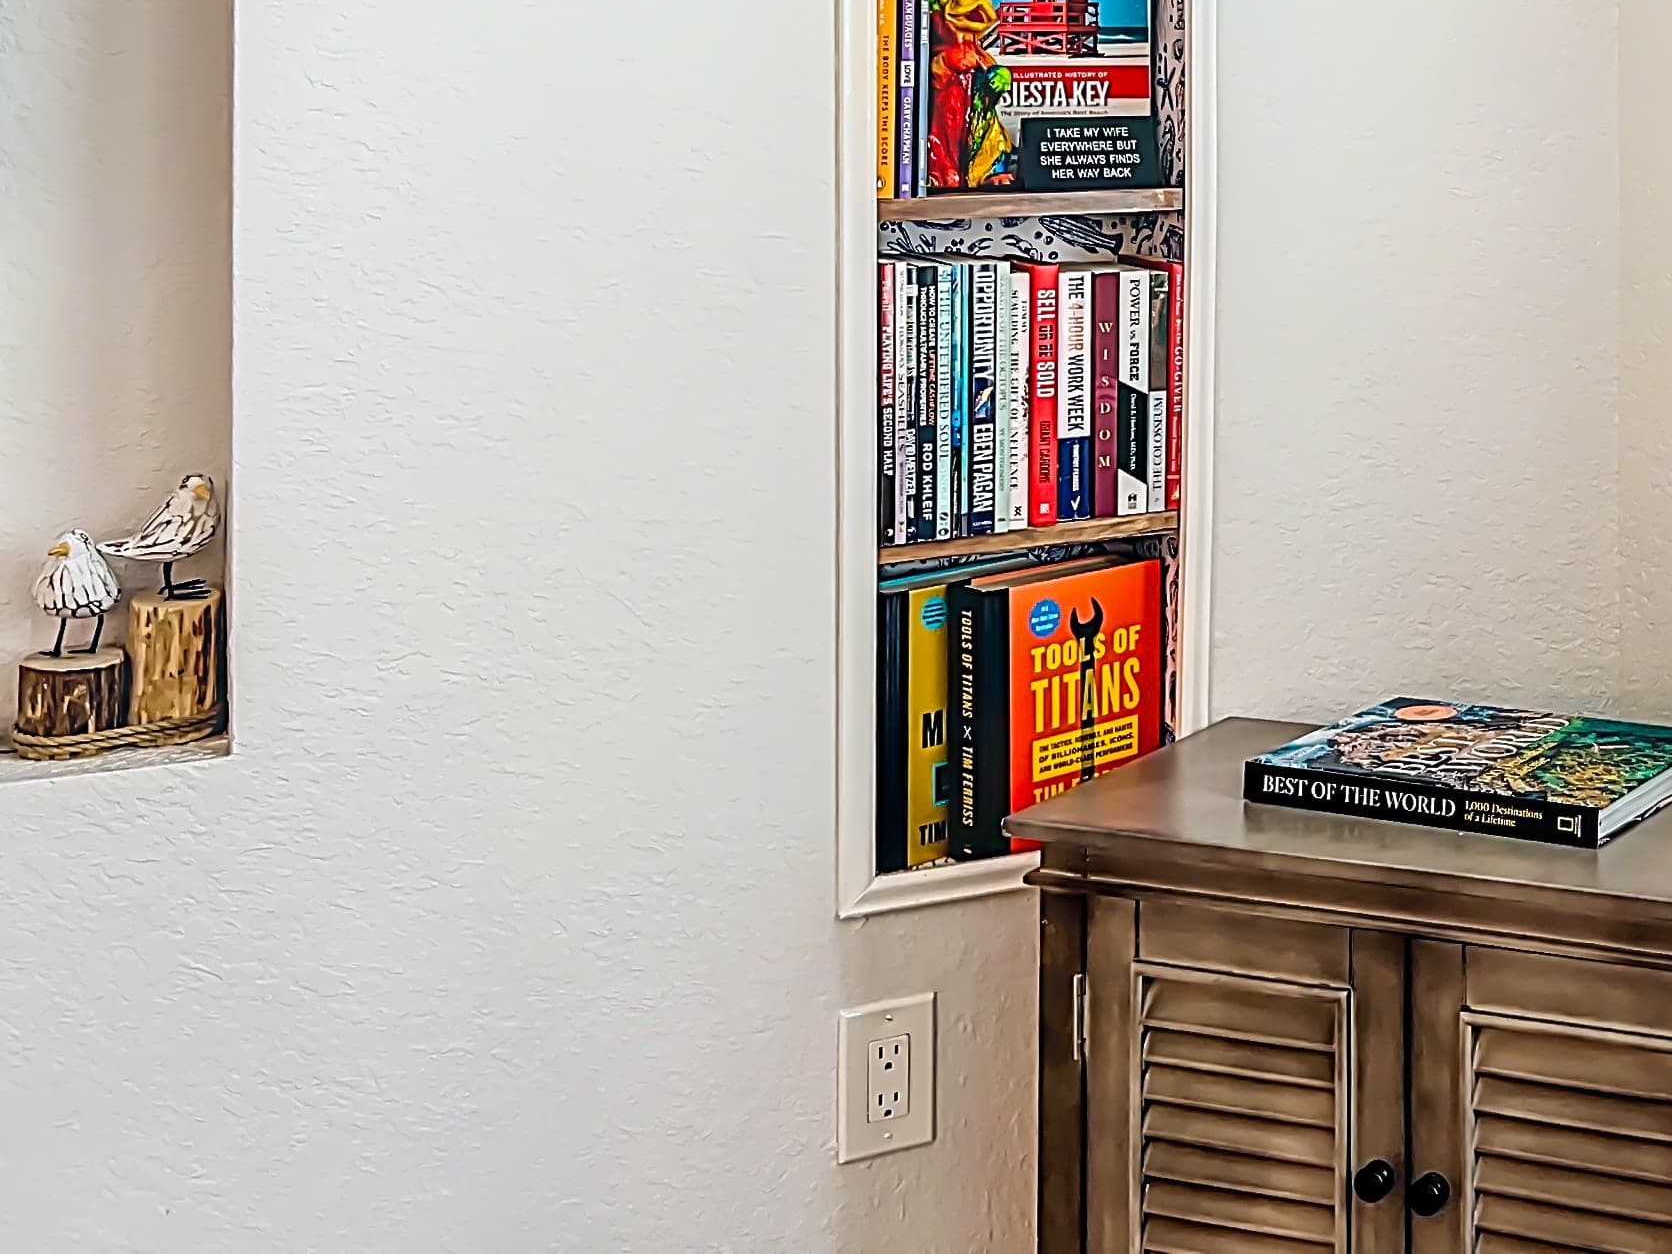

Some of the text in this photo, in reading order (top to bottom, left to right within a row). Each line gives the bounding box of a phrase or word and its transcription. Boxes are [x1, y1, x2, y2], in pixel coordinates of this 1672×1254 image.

[1000, 81, 1109, 106] SIESTA KEY
[902, 122, 910, 164] CHAPMAN
[1041, 140, 1137, 151] EVERYWHERE BUT
[1047, 127, 1128, 138] I TAKE MY WIFE
[1040, 154, 1140, 165] SHE ALWAYS FINDS
[1052, 168, 1131, 179] HER WAY BACK
[928, 305, 935, 313] TO
[940, 286, 950, 318] THE
[974, 271, 994, 381] OPPORTUNITY
[1011, 290, 1019, 345] SPAULDING
[1037, 289, 1055, 322] SELL
[1067, 276, 1084, 432] THE 4-HOUR WORK WEEK
[1130, 279, 1140, 381] POWER FORCE
[939, 322, 950, 420] UNTETHERED
[1010, 352, 1019, 373] THE
[1036, 362, 1054, 398] SOLD
[1173, 346, 1182, 412] GO-GIVER
[882, 326, 893, 476] PLAYING LIFE'S SECOND HALF
[1099, 322, 1112, 468] WISDOM
[906, 428, 916, 495] DAVID MELTZER
[939, 424, 950, 462] SOUL
[973, 423, 993, 512] EBEN PAGAN
[1010, 426, 1018, 491] INFLUENCE
[1039, 421, 1050, 483] GRANT CARDONE
[1153, 397, 1164, 490] THE COLOSSEUM
[922, 443, 932, 521] ROD KHLEIF
[1031, 624, 1140, 673] TOOLS OF
[961, 610, 973, 826] TOOLS OF TITANS TIM FERRISS
[1031, 657, 1140, 734] TITANS
[1263, 774, 1456, 817] BEST OF THE WORLD
[1464, 812, 1473, 821] of
[1482, 814, 1516, 827] Lifetime
[1465, 800, 1543, 819] 1,000 Destinations
[919, 819, 947, 846] TIM
